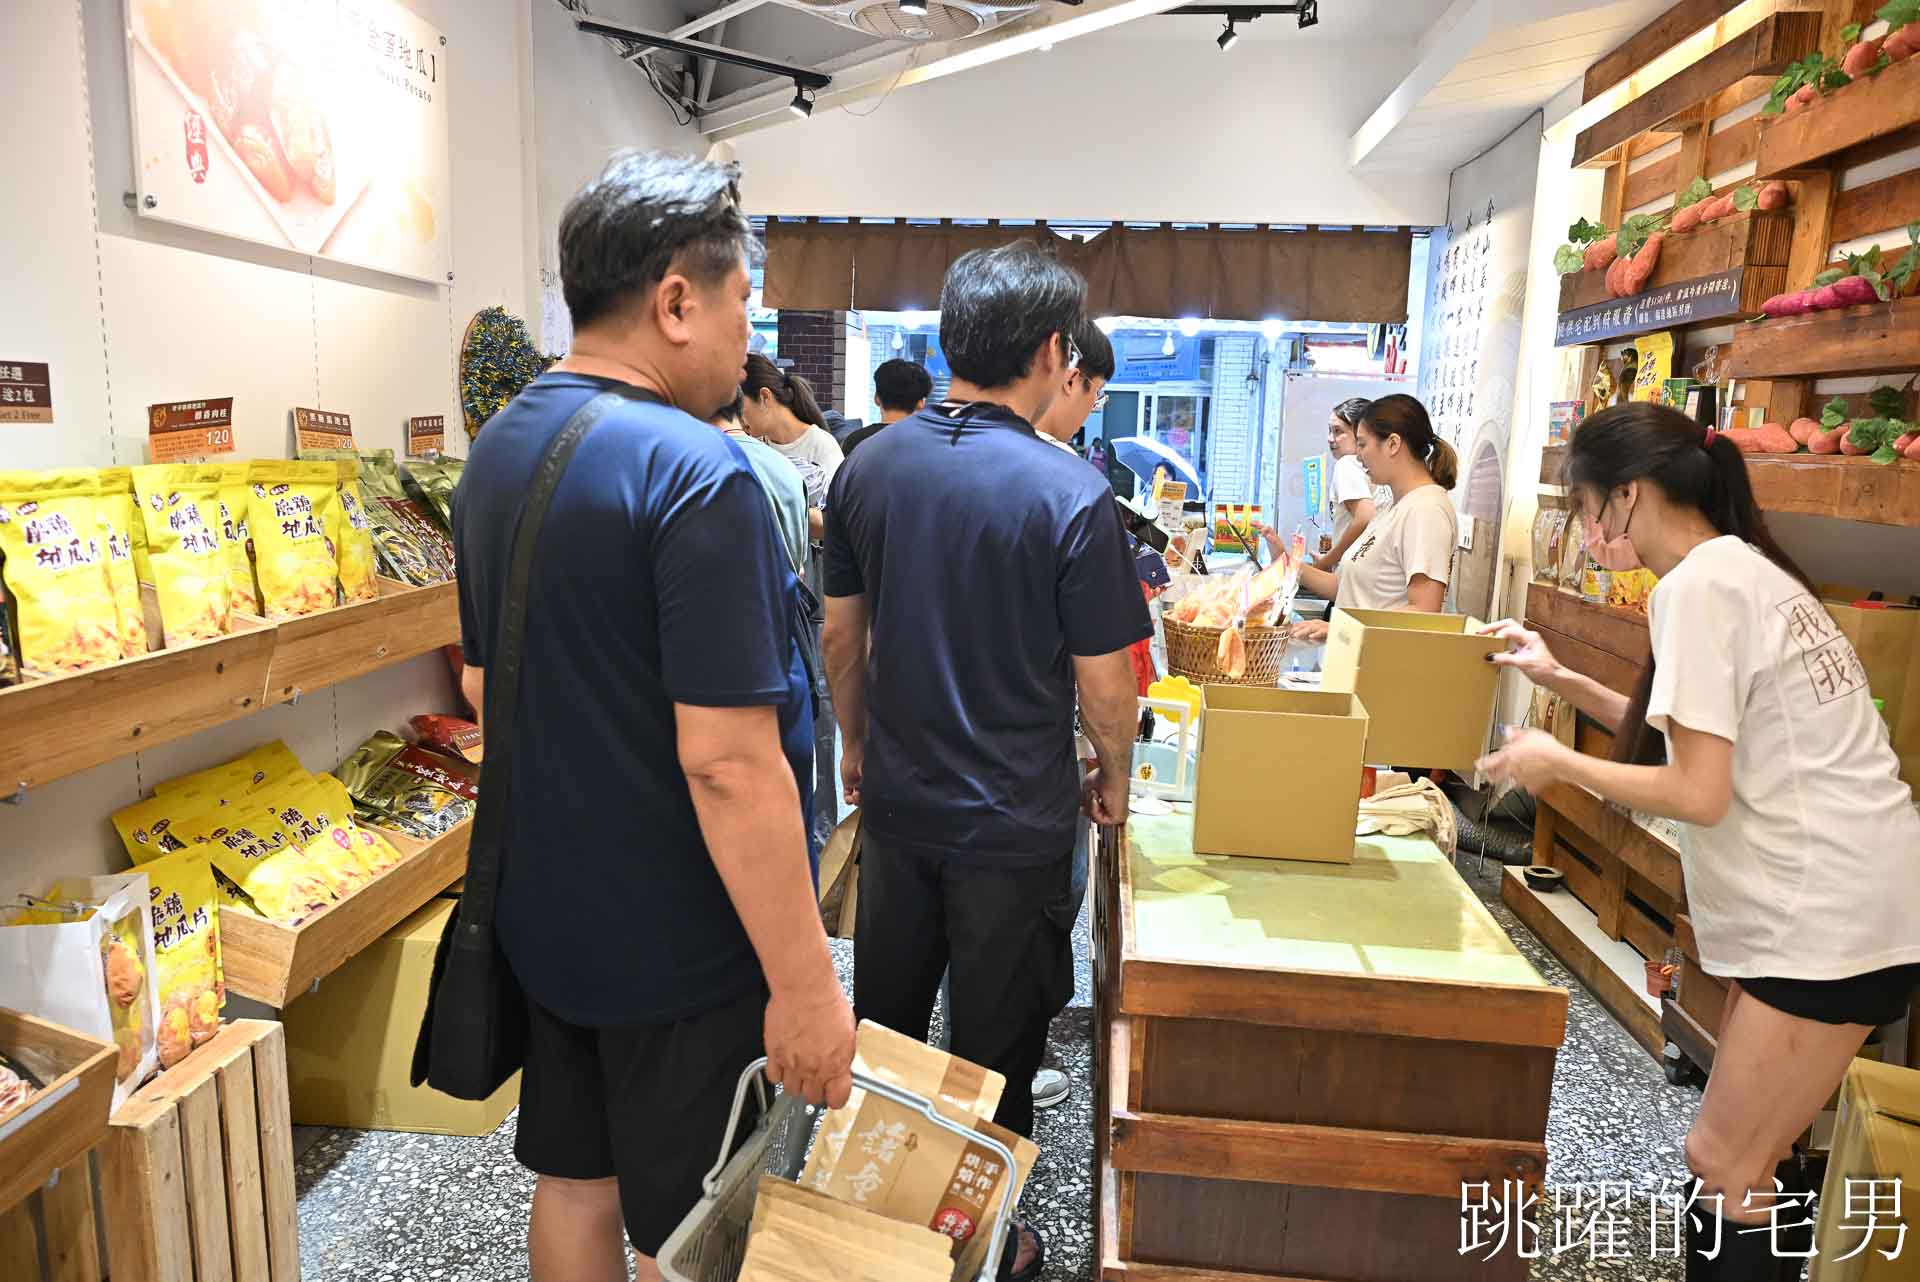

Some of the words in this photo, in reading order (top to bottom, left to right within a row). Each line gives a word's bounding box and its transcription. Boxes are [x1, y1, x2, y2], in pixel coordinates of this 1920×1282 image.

[206, 429, 230, 446] 120
[336, 438, 353, 449] 120
[182, 528, 219, 553] 地瓜
[1814, 649, 1854, 696] 我
[239, 831, 288, 859] 地瓜片
[153, 906, 208, 949] 地瓜片
